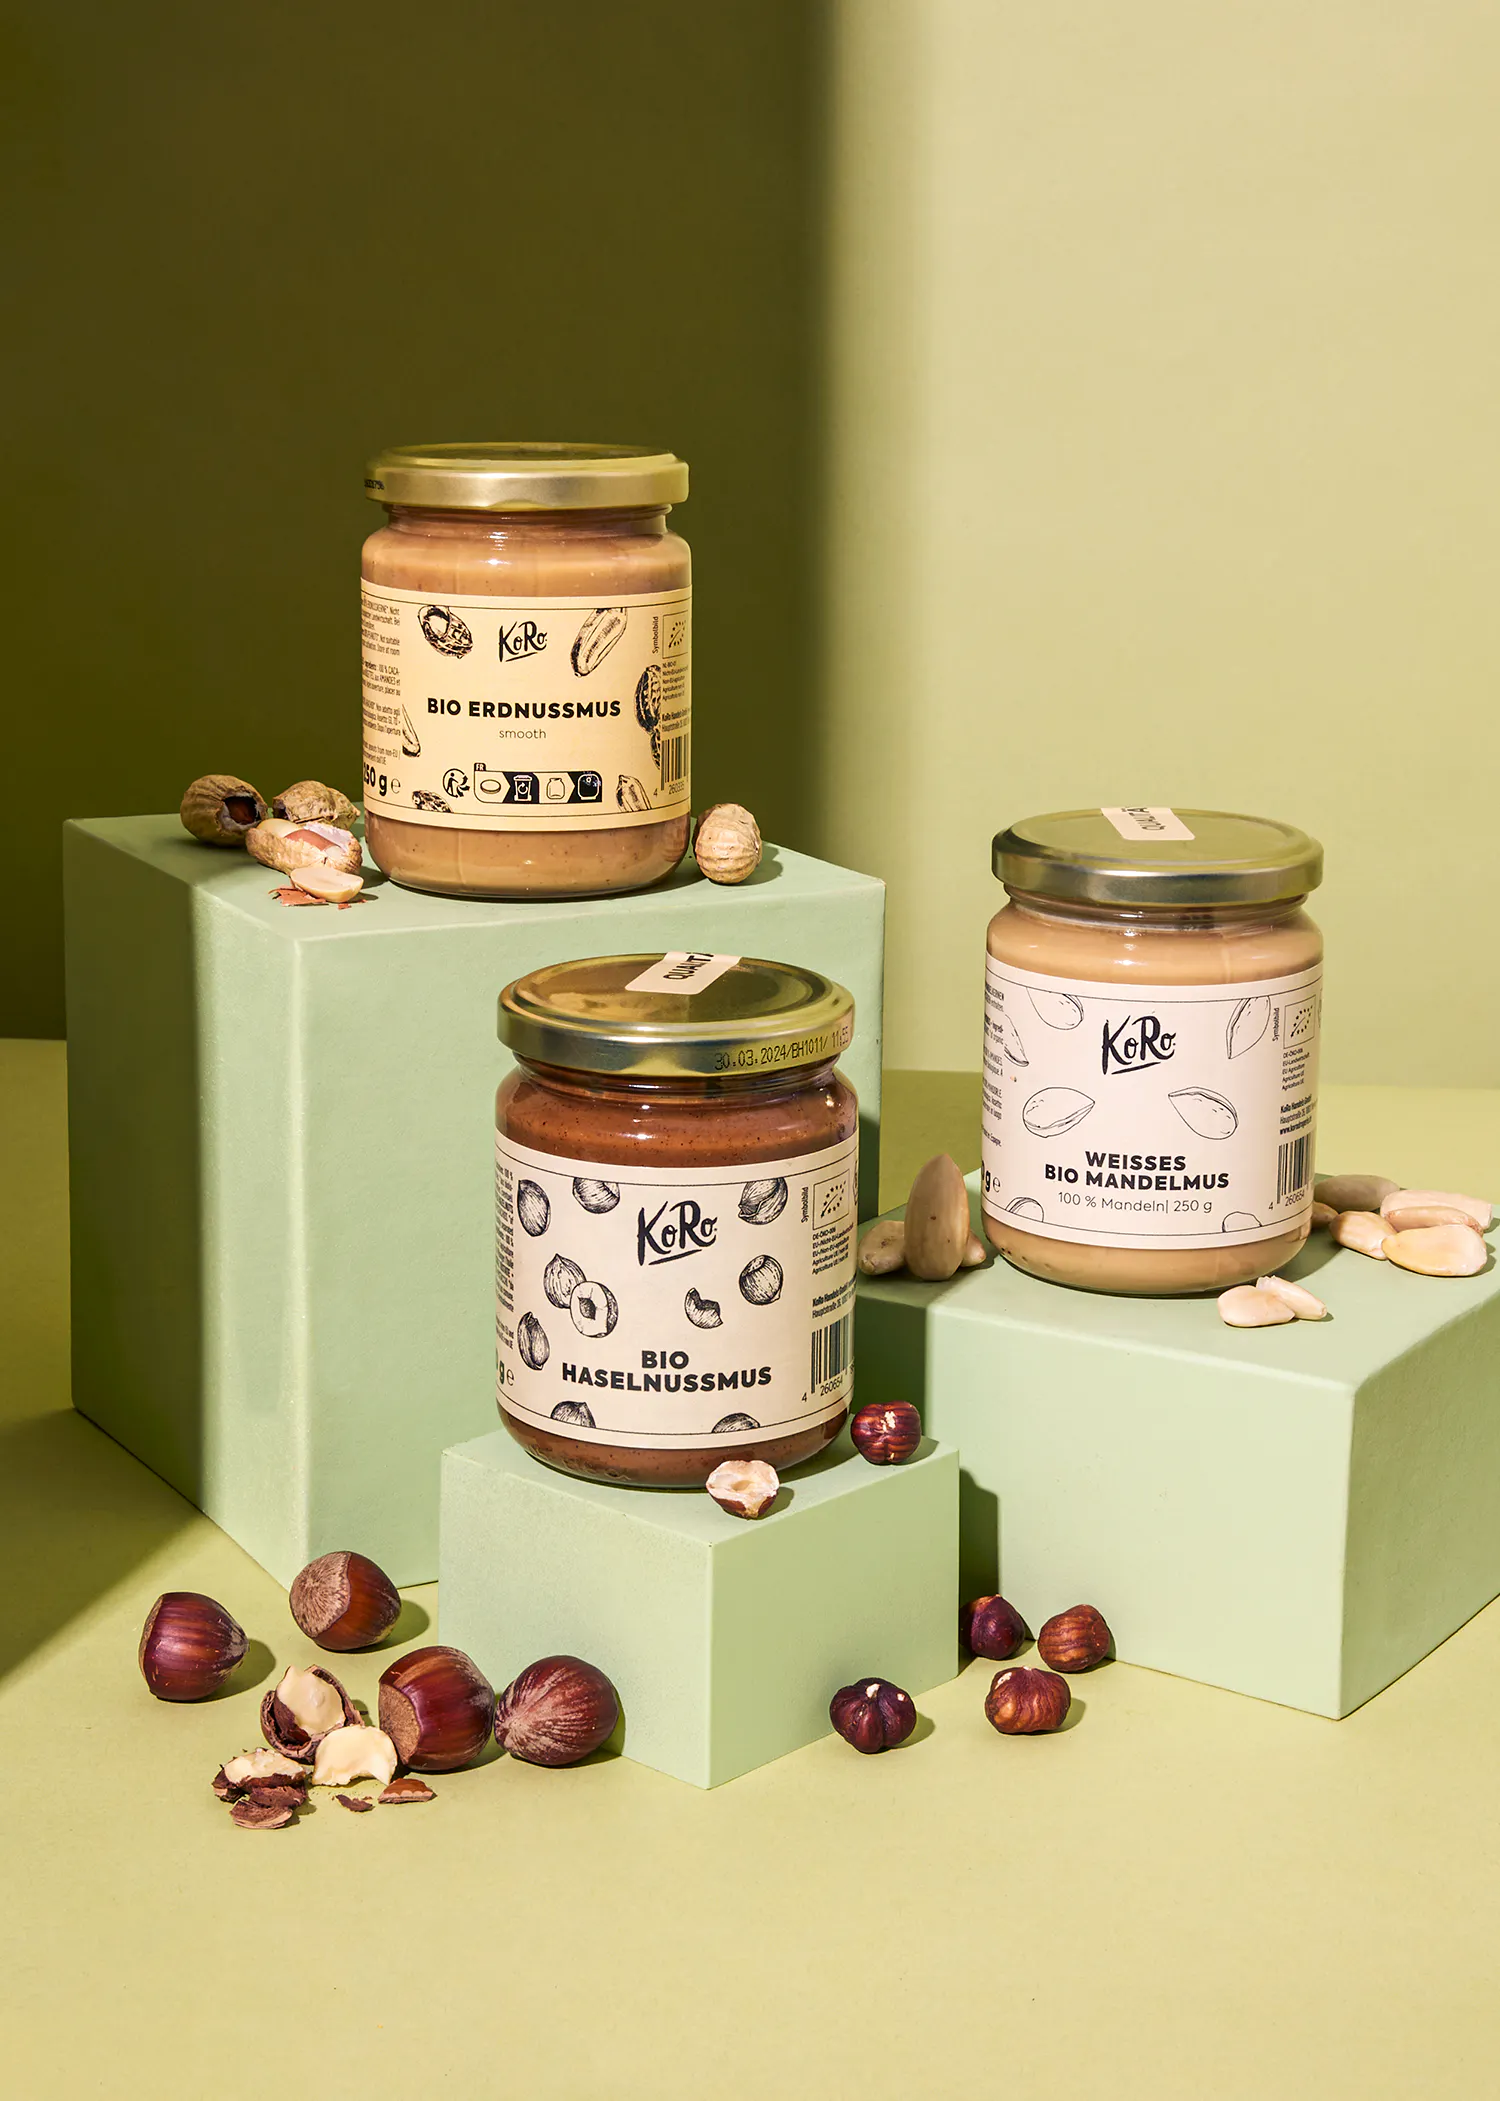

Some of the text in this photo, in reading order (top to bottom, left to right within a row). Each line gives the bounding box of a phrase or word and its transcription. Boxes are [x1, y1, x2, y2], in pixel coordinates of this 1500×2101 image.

[499, 621, 547, 662] KoRo
[428, 698, 621, 719] BIO ERDNUSSMUS
[499, 729, 547, 739] smooth
[379, 774, 387, 797] g
[1272, 1007, 1280, 1042] Symbolbild
[1102, 1015, 1176, 1075] KoRo
[1085, 1151, 1186, 1171] WEISSES
[1045, 1164, 1229, 1190] BIO MANDELMUS
[1058, 1192, 1081, 1206] 100
[1085, 1196, 1097, 1208] %
[1173, 1200, 1199, 1212] 250
[1203, 1201, 1212, 1214] g
[637, 1200, 718, 1266] KoRo
[641, 1350, 690, 1369] BIO
[562, 1362, 772, 1393] HASELNUSSMUS
